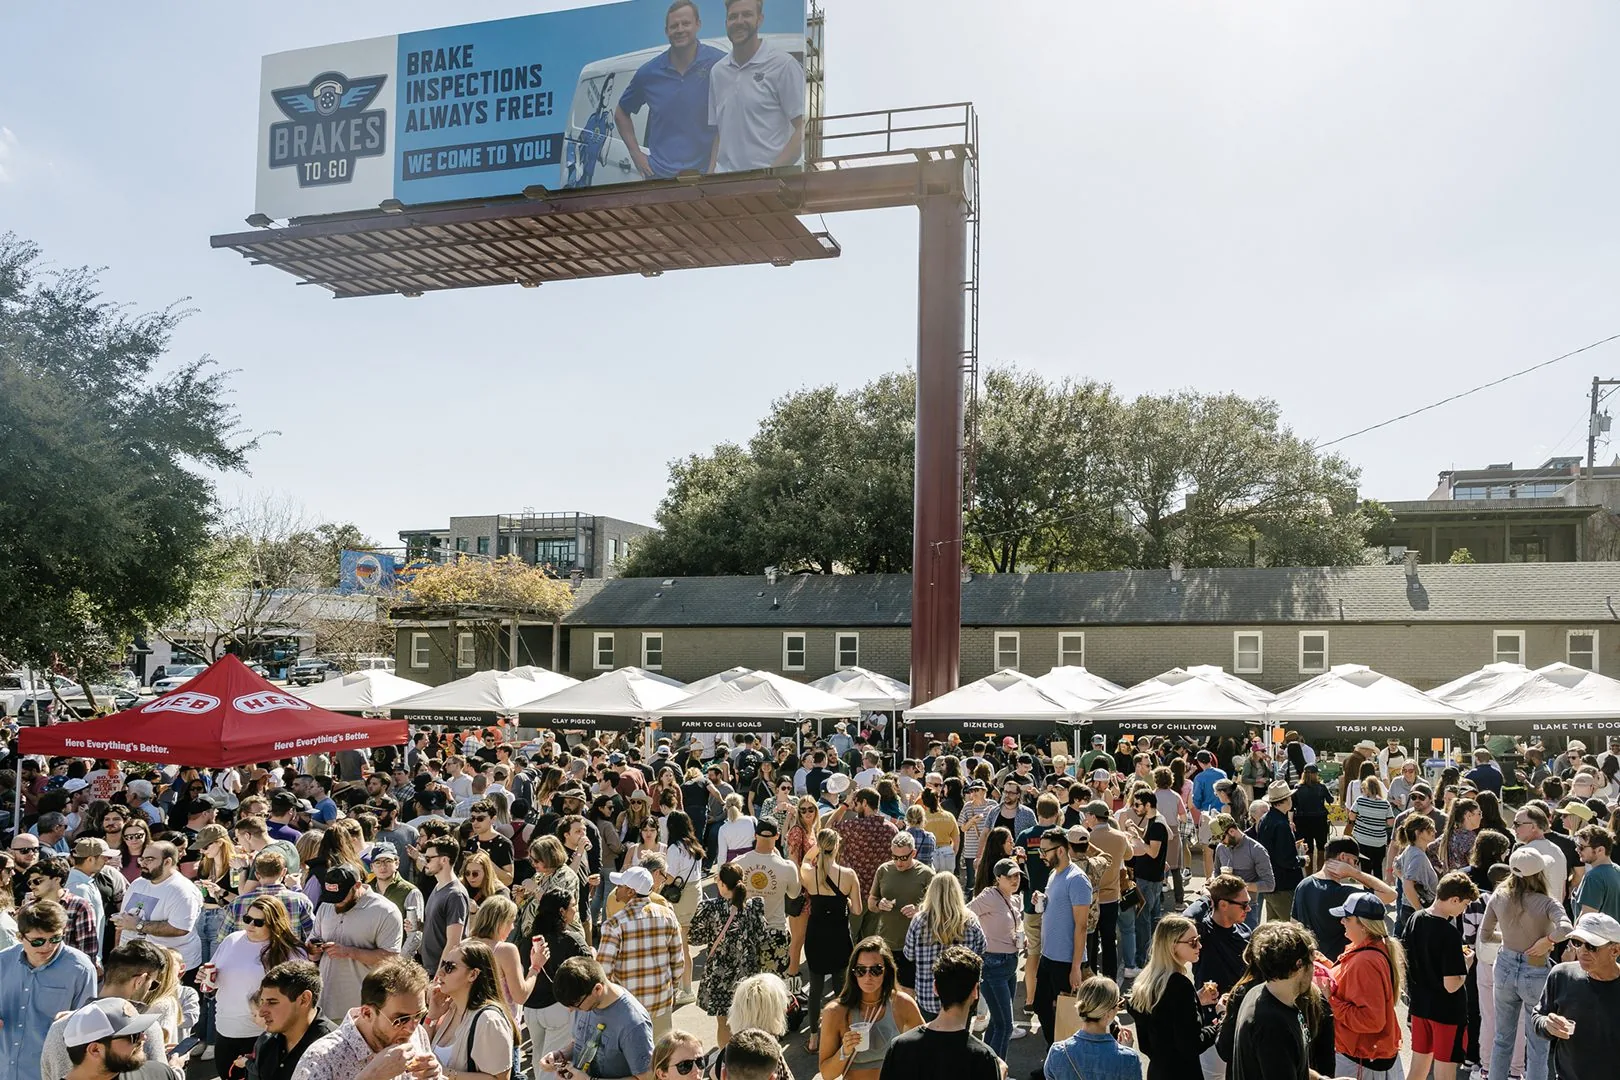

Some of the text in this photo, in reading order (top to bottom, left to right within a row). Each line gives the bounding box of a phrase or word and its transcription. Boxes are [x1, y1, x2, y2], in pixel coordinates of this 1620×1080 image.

[407, 44, 474, 76] BRAKE
[406, 64, 543, 104] INSPECTIONS
[405, 100, 488, 133] ALWAYS
[496, 91, 553, 122] FREE!
[275, 116, 380, 160] BRAKES
[304, 159, 347, 181] TO GO
[408, 139, 551, 174] WE COME TO YOU!
[65, 738, 169, 754] Here Everything's Better.
[274, 732, 369, 750] Here Everything's Better.
